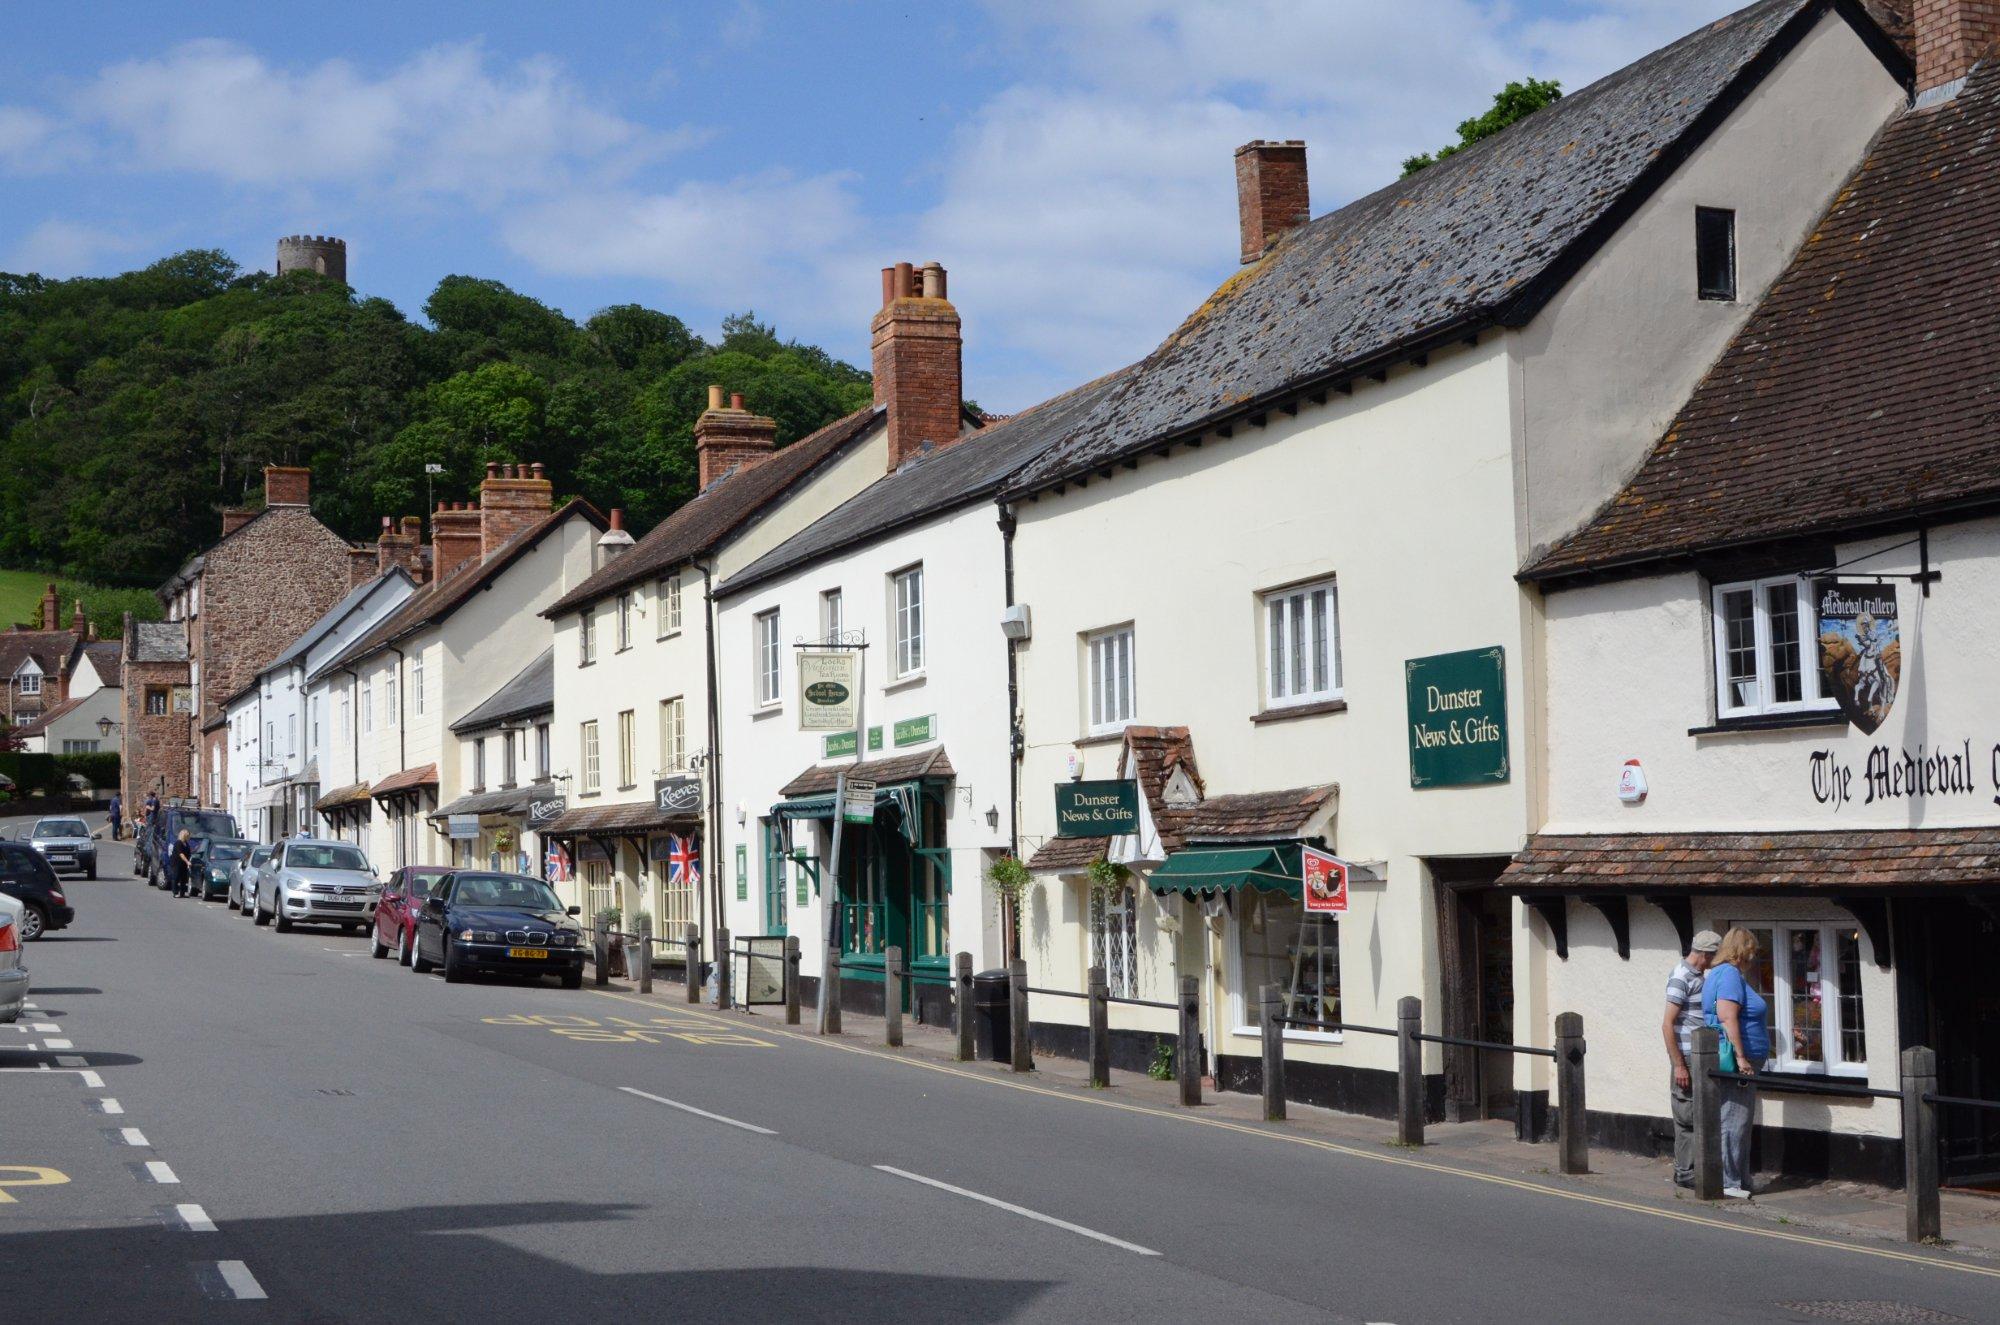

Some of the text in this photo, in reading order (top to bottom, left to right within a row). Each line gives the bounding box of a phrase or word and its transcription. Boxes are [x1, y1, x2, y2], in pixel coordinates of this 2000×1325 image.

[1827, 590, 1840, 598] The
[1821, 596, 1862, 616] Medieval
[807, 690, 827, 698] School
[1427, 686, 1483, 712] Dunster
[911, 725, 928, 737] Dunster
[1414, 716, 1500, 749] News & Gifts
[842, 739, 856, 750] Dunster
[1809, 748, 1852, 813] The
[1864, 738, 1975, 805] Medieval
[658, 783, 700, 809] Reeves
[1074, 794, 1119, 806] Dunster
[529, 798, 565, 820] Reeves
[1062, 808, 1133, 822] News & Gifts
[480, 1014, 731, 1030] STOP
[550, 1029, 779, 1047] BUS
